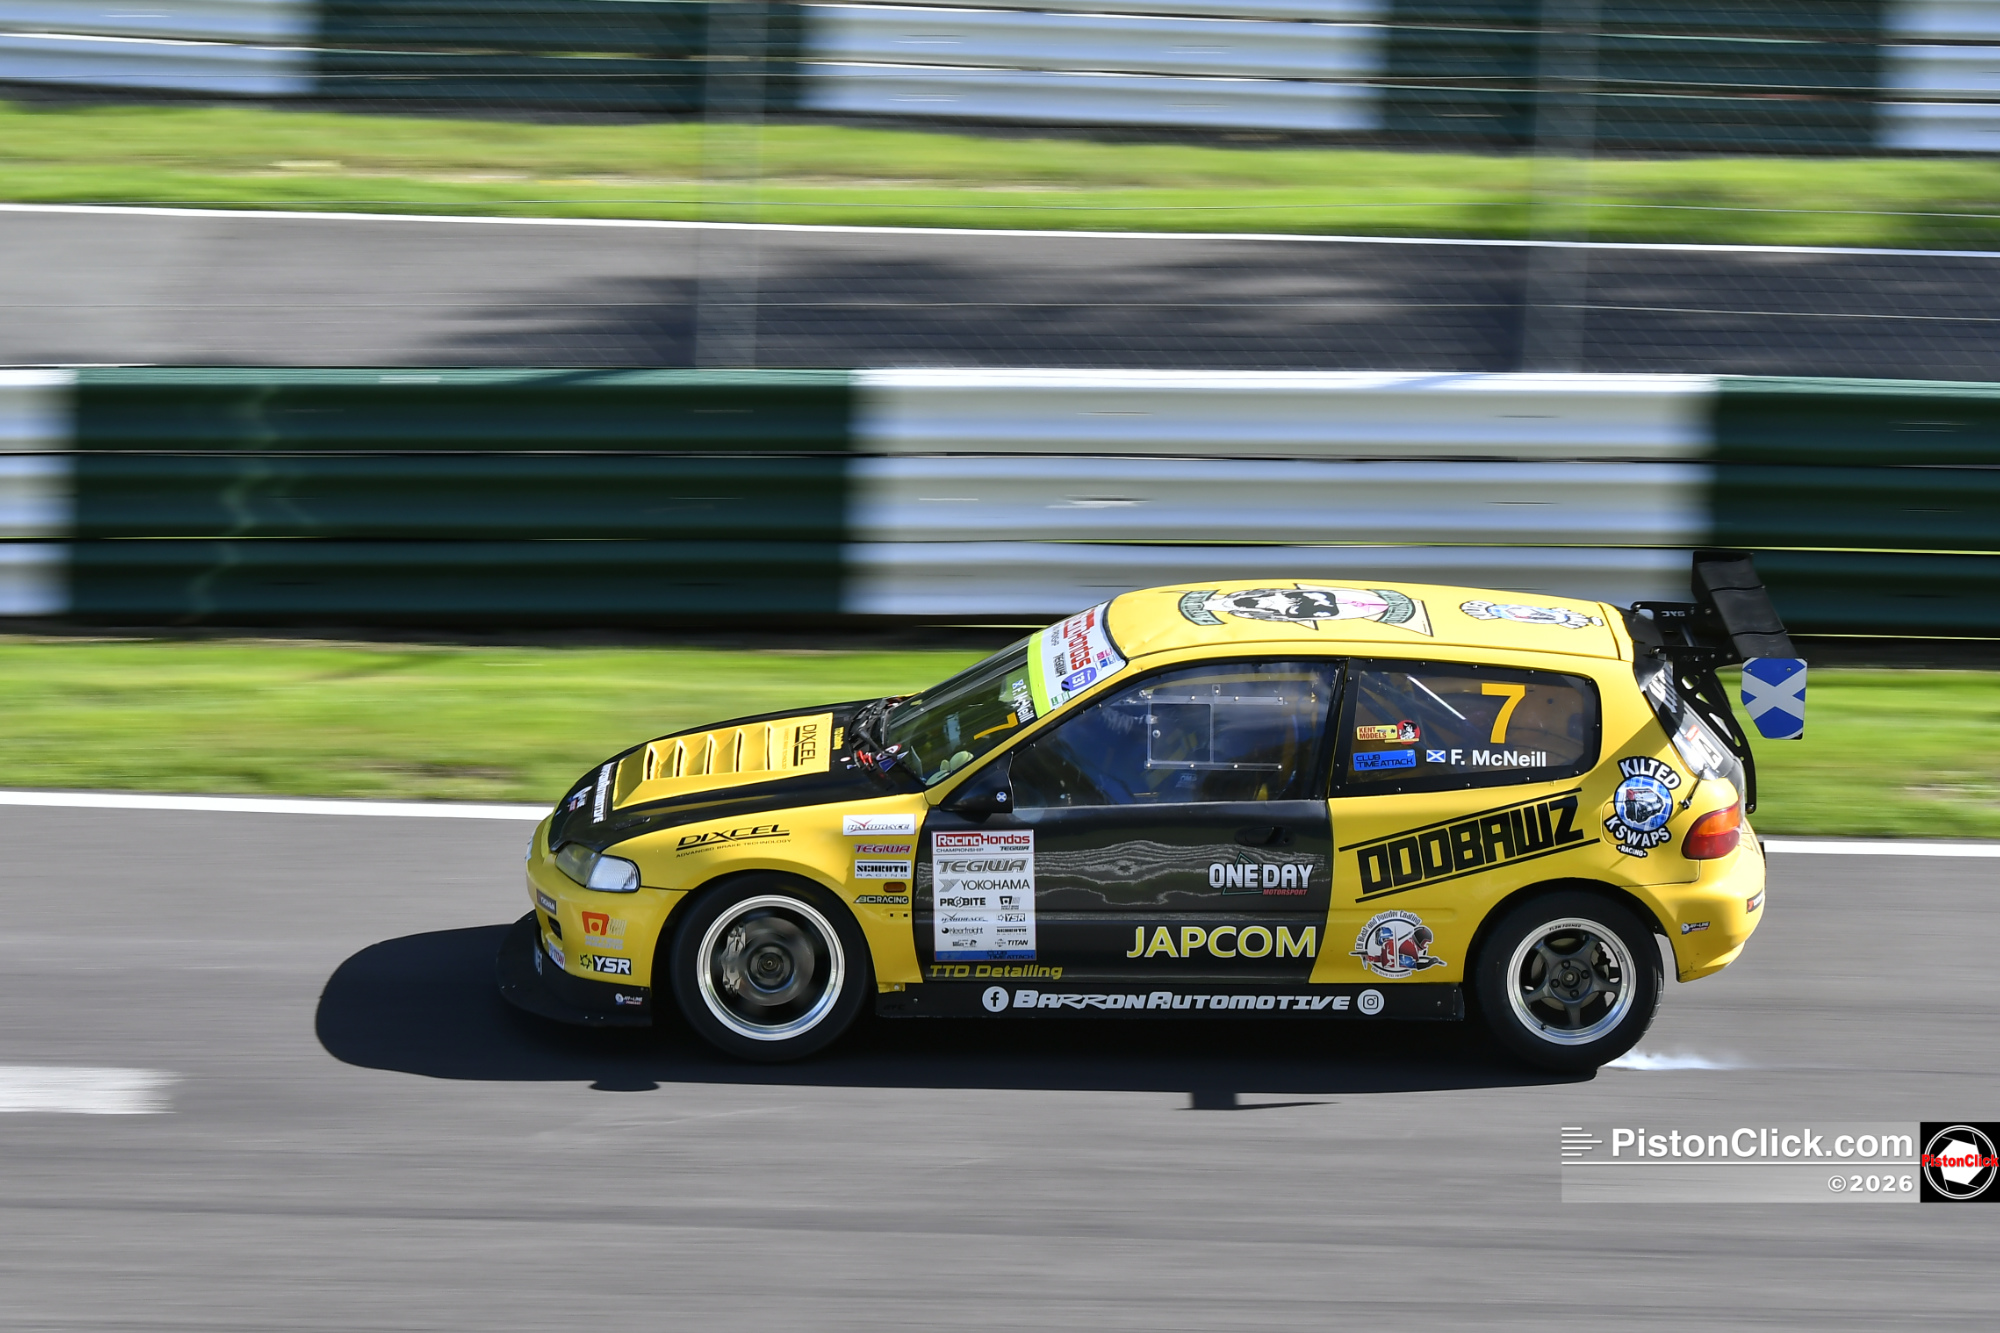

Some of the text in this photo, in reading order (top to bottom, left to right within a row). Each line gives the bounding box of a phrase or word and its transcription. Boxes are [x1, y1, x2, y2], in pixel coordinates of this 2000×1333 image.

[1481, 683, 1526, 743] 7
[800, 724, 817, 766] DIXCEL
[1356, 754, 1381, 762] CLUB
[1450, 749, 1547, 767] F. McNeill
[1619, 758, 1680, 789] KILTED
[677, 824, 790, 848] DIXCEL
[1606, 816, 1670, 847] K SWAPS
[855, 844, 912, 854] TEGIWA
[1620, 845, 1644, 857] RACING
[937, 859, 1028, 874] TEGIWA
[961, 879, 1030, 890] YOKOHAMA
[939, 896, 986, 908] PROBITE
[1127, 926, 1317, 958] JAPCOM
[594, 956, 631, 975] YSR
[930, 965, 1063, 980] TTD Detailing
